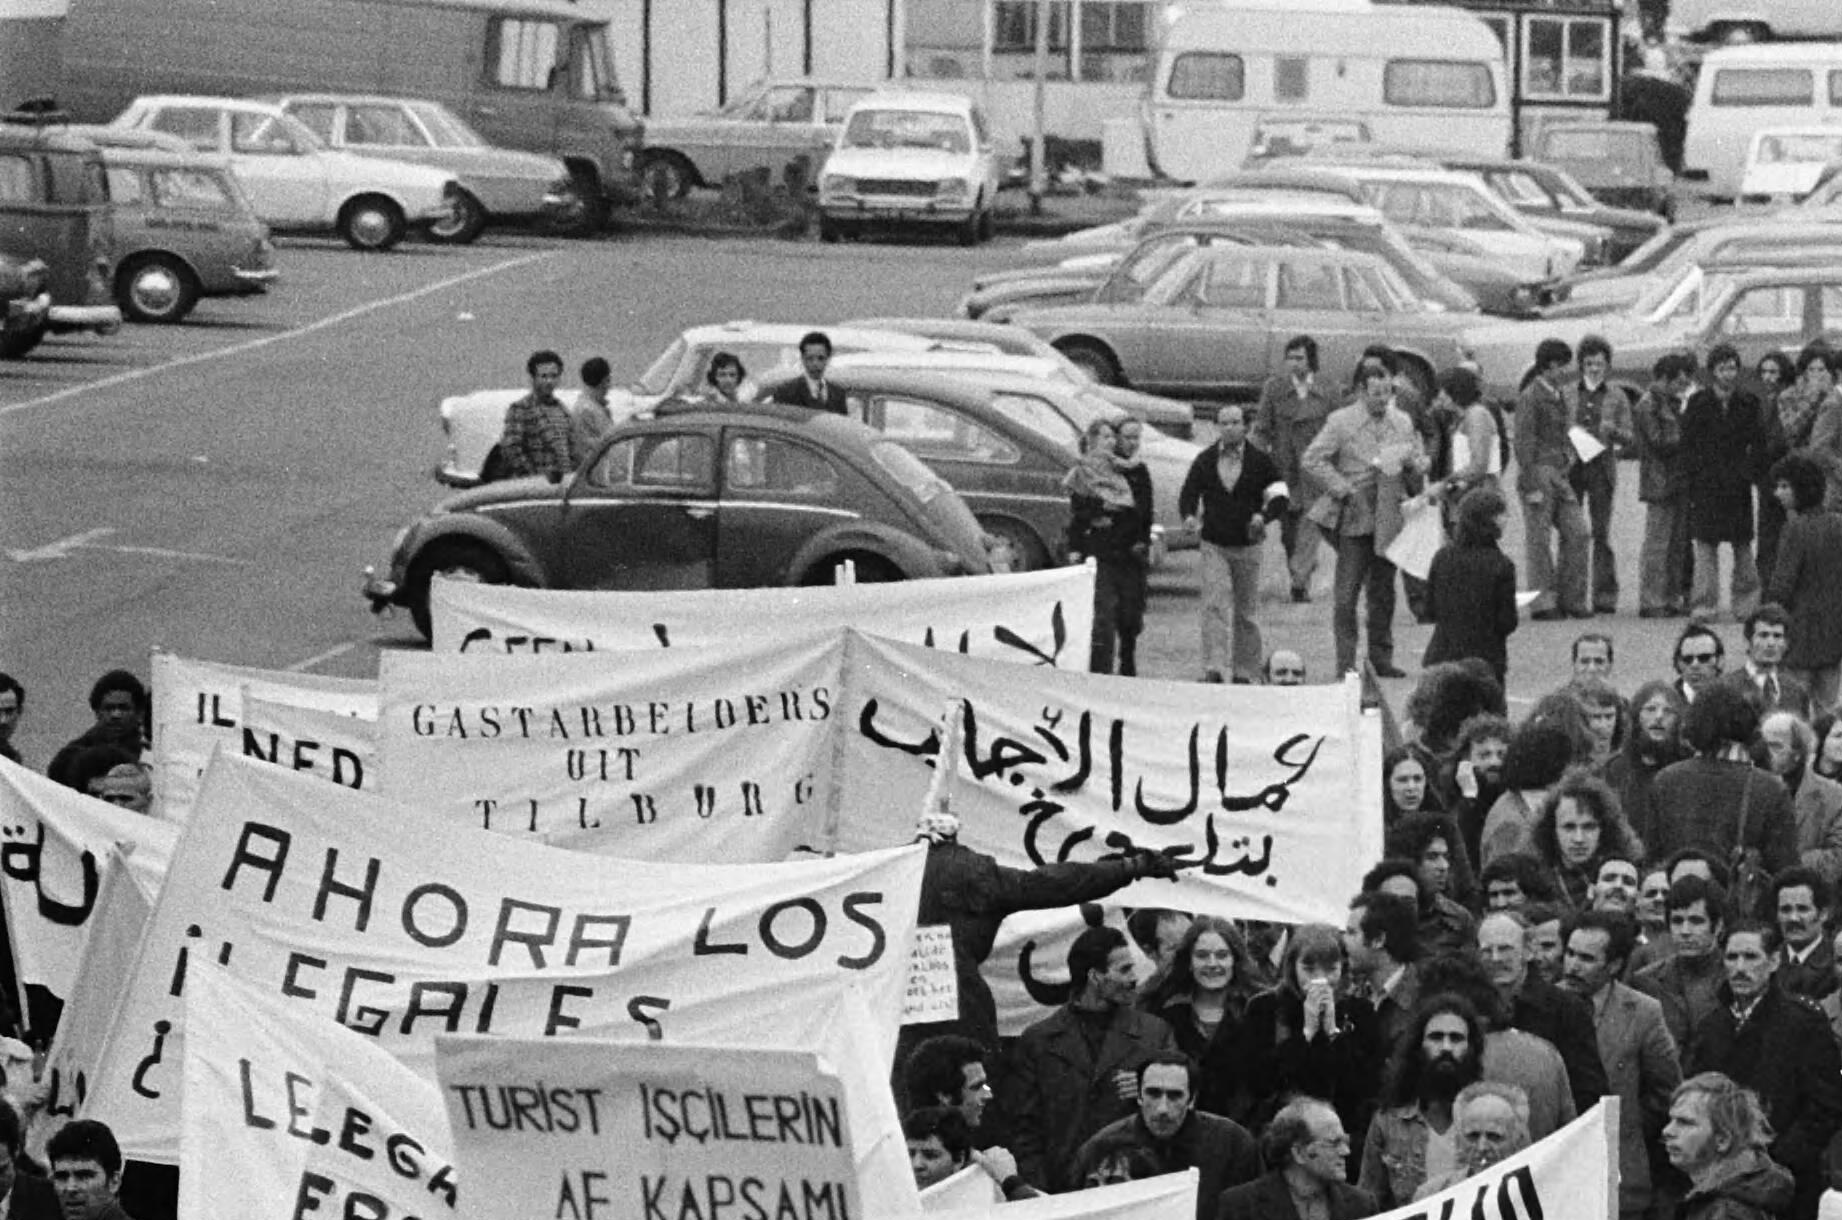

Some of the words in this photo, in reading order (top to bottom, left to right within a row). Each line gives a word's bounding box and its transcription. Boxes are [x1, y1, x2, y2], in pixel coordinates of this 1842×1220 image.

[412, 686, 832, 739] GASTARBEIDERS
[567, 747, 641, 782] UIT
[221, 821, 630, 968] AHORA
[693, 891, 886, 971] LOS
